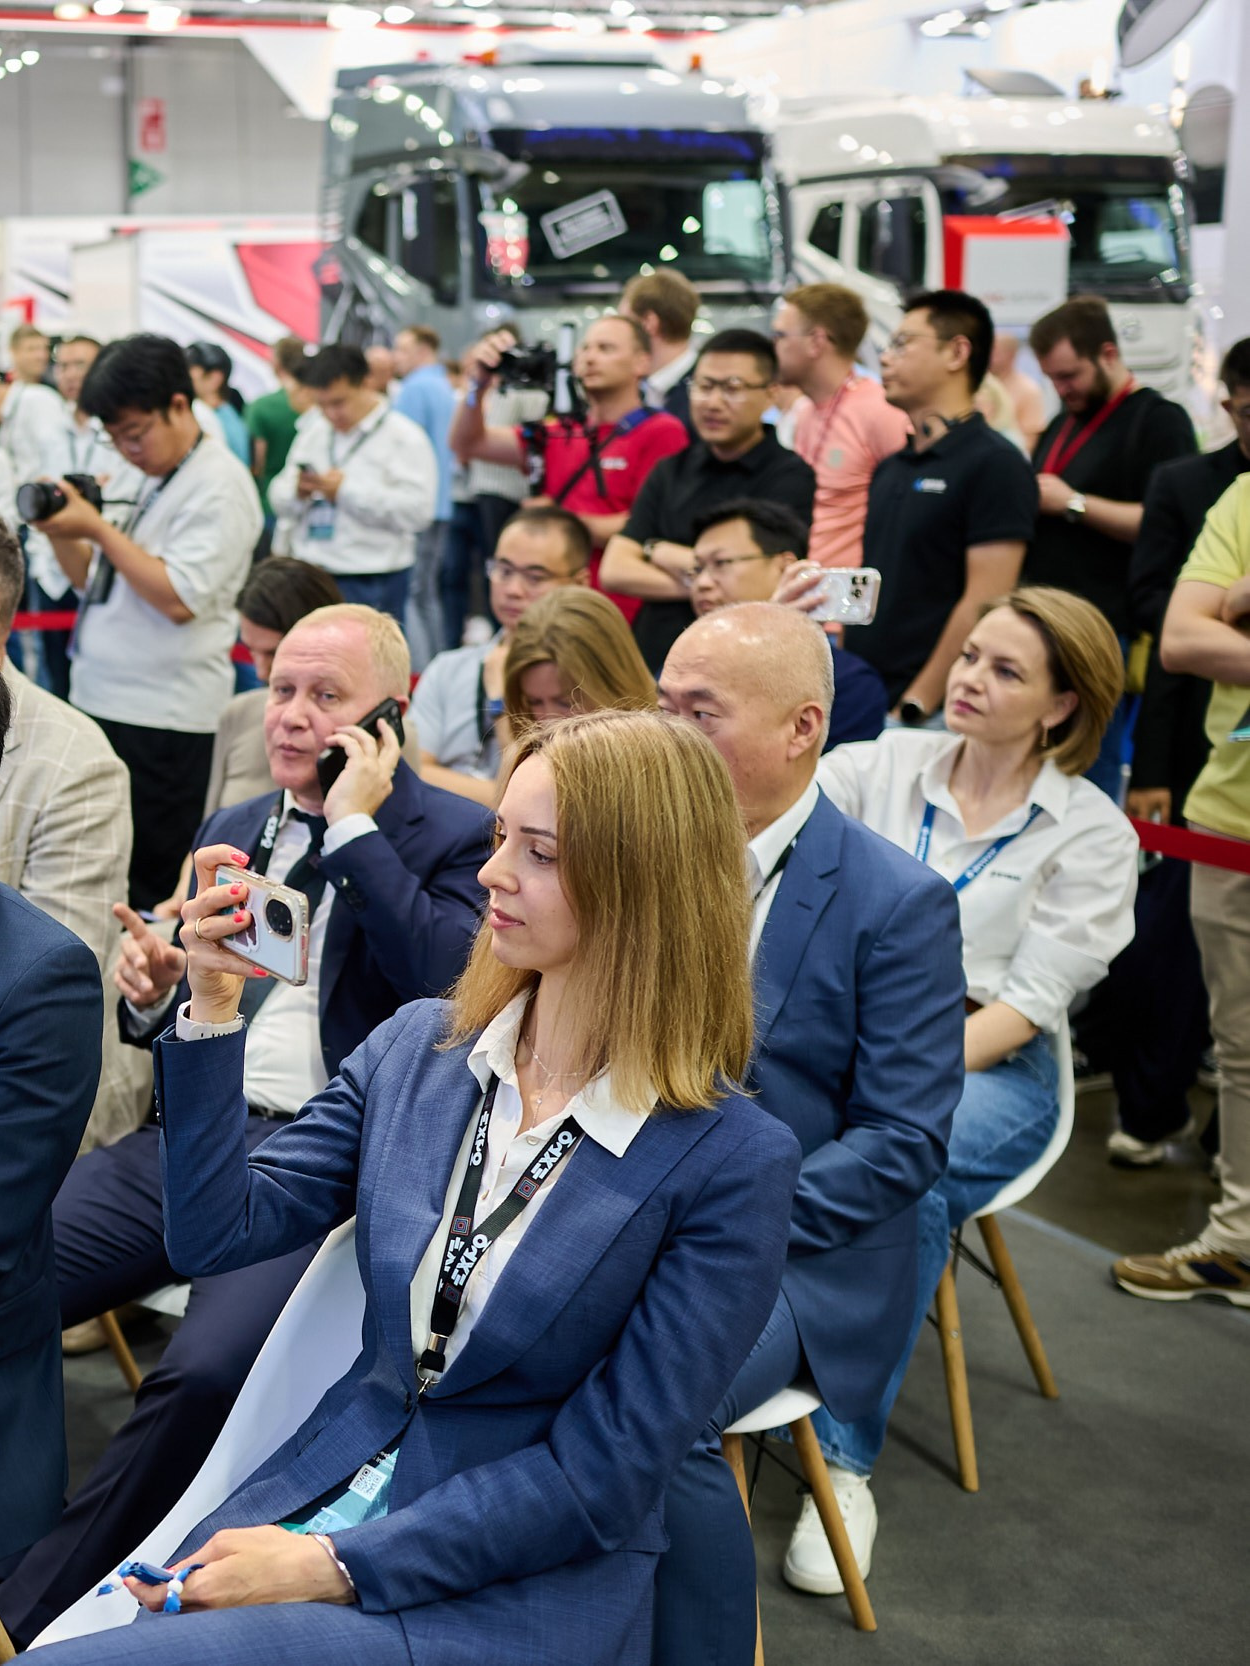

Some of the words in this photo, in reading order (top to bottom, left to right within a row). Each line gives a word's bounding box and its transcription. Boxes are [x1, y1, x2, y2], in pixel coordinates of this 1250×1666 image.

[469, 1110, 490, 1167] EXPO
[530, 1130, 577, 1181] EXPO
[451, 1233, 492, 1287] EXPO
